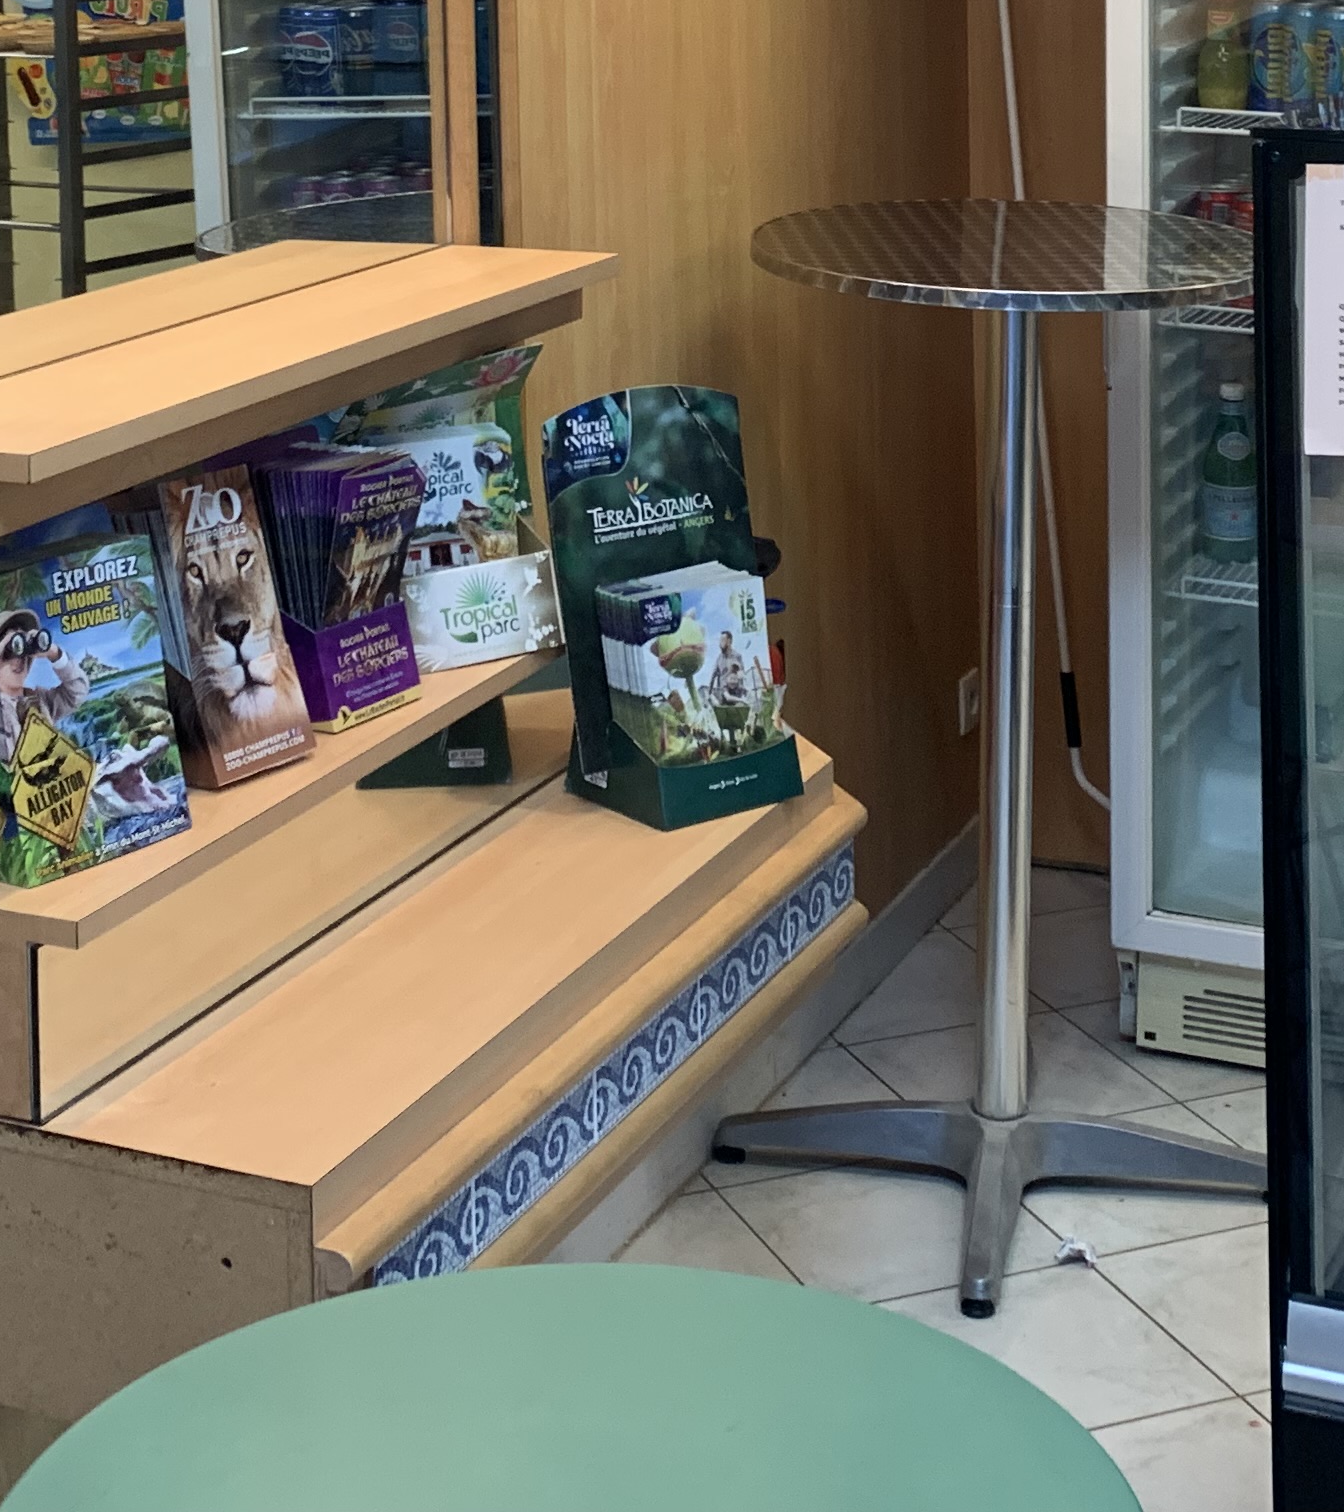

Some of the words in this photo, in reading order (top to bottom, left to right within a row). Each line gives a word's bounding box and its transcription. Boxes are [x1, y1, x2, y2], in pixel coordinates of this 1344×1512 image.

[180, 483, 242, 535] ZOO
[586, 506, 636, 529] TERRA
[643, 492, 714, 520] BOTANICA
[683, 515, 715, 529] ANGERS
[51, 556, 139, 595] EXPLOREZ
[46, 599, 63, 616] UN
[64, 585, 113, 614] MONDE
[440, 594, 519, 631] Tropical
[61, 605, 121, 634] SAUVAGE
[481, 617, 521, 644] parc
[51, 797, 75, 827] BAY
